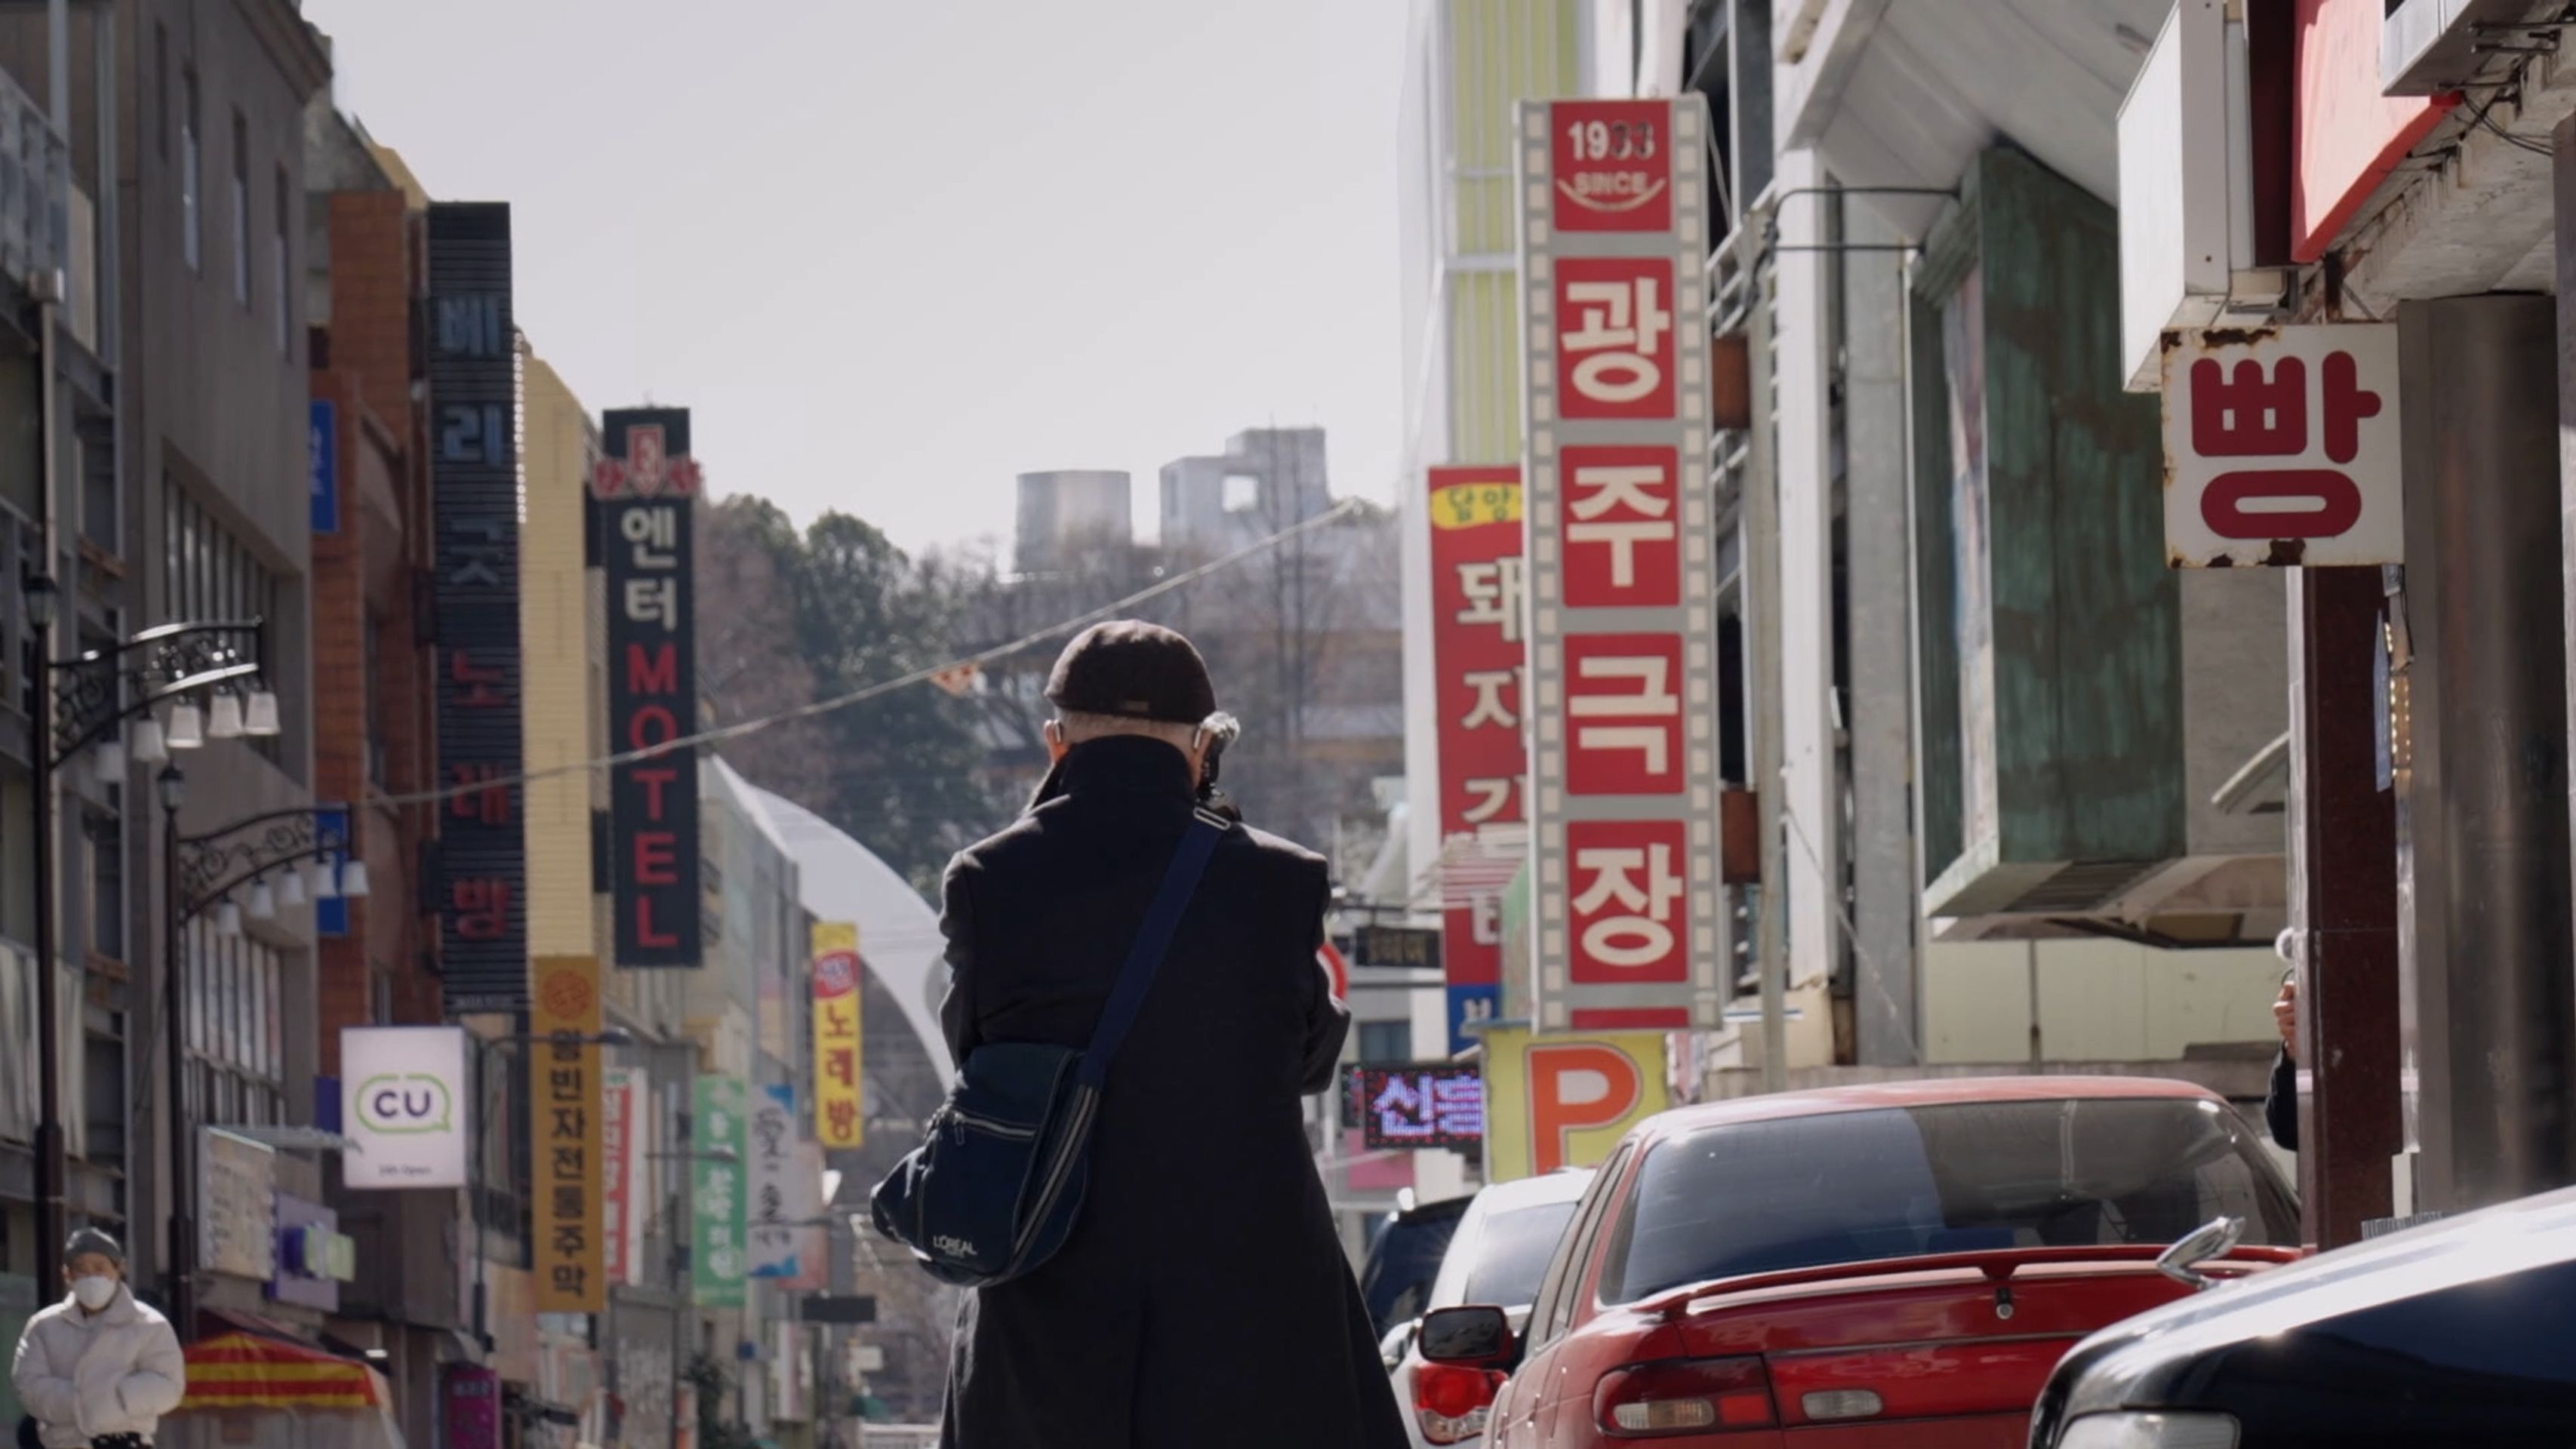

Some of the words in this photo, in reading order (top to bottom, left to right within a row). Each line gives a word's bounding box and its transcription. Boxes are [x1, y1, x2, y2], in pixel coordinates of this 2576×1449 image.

[1574, 171, 1648, 195] SINCE
[2191, 351, 2381, 540] 빵
[621, 506, 678, 631] 엔터
[1560, 277, 1684, 967] 광주극장
[451, 651, 512, 940] 노래방
[626, 644, 678, 947] MOTEL
[374, 1089, 431, 1118] CU
[824, 1003, 858, 1141] 노래방
[1524, 1042, 1644, 1176] P
